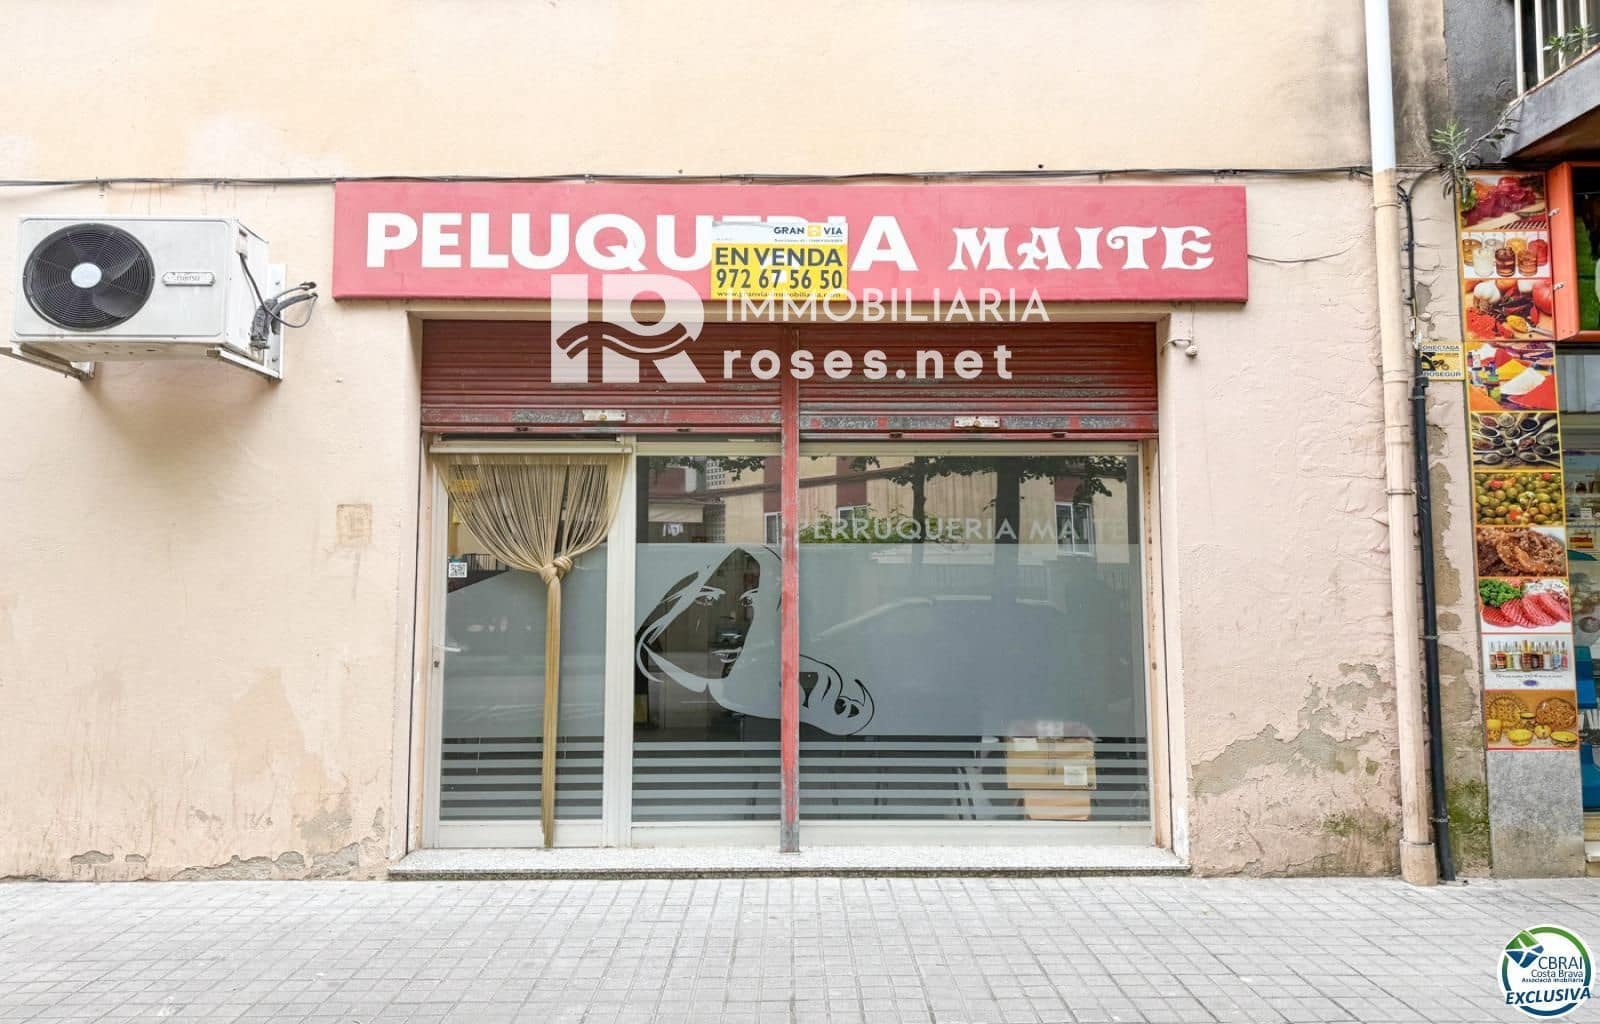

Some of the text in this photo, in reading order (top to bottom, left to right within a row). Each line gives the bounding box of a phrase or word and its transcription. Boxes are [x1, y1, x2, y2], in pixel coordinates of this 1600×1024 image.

[773, 226, 843, 235] GRAN VIA
[366, 212, 1214, 272] PELUQUA MAITE
[715, 247, 843, 267] EN VENDA
[716, 268, 843, 290] 972 67 56 50
